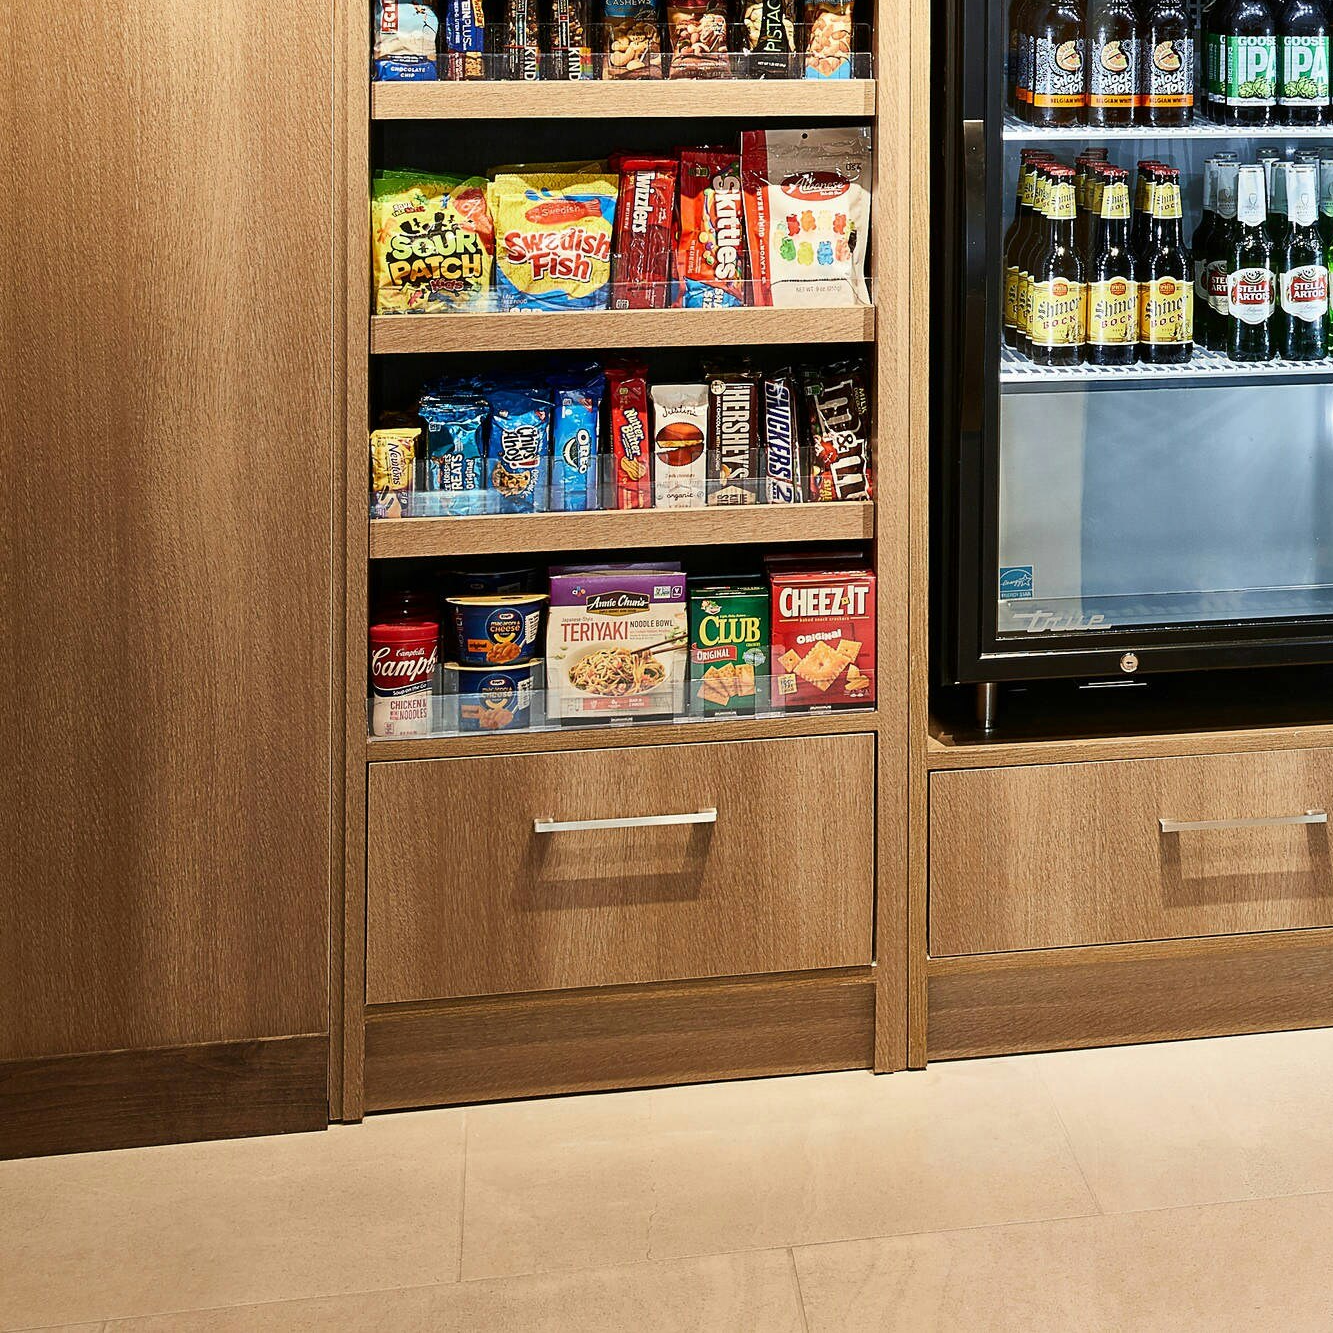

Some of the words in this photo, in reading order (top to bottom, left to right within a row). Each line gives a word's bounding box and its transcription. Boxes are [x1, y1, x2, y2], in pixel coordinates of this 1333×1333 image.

[1238, 36, 1277, 46] GOOSE
[1284, 36, 1326, 46] GOOSE
[525, 46, 536, 81] KIND
[569, 47, 580, 81] KIND
[1238, 46, 1277, 85] IPA
[1284, 46, 1329, 85] IPA
[1054, 71, 1084, 88] SHOCK
[1067, 81, 1084, 94] TOP
[1100, 71, 1133, 88] SHOCK
[1112, 81, 1132, 94] TOP
[1152, 71, 1186, 88] SHOCK
[1163, 81, 1184, 94] TOP
[542, 205, 580, 217] Swedish
[632, 171, 655, 233] Twizzlers
[713, 175, 740, 280] Skittles
[391, 229, 476, 260] SOUR
[504, 227, 611, 262] Swedish
[389, 254, 482, 286] PATCH
[529, 251, 591, 281] Fish
[1237, 284, 1269, 293] STELLA
[1237, 292, 1270, 301] ARTOIS
[1293, 282, 1325, 291] STELLA
[1293, 290, 1325, 299] ARTOIS
[1038, 297, 1081, 320] Shiner
[1095, 296, 1138, 320] Shiner
[1145, 295, 1188, 321] Shiner
[1043, 315, 1077, 329] BOCK
[1101, 314, 1133, 328] BOCK
[1151, 313, 1184, 328] BOCK
[858, 387, 868, 415] MILK
[623, 408, 645, 439] Nutter
[722, 388, 750, 479] HERSHEY'S
[765, 383, 792, 481] SNICKERS
[516, 426, 538, 460] Chips
[577, 429, 590, 474] OREO
[621, 425, 641, 456] Butter
[388, 443, 401, 485] Newtons
[451, 454, 463, 494] REATS
[465, 459, 475, 490] Original
[666, 492, 693, 501] organic
[777, 485, 792, 503] 2
[587, 596, 616, 610] Annie
[618, 594, 649, 607] Chun's
[561, 621, 628, 642] TERIYAKI
[699, 615, 761, 646] CLUB
[1013, 609, 1113, 633] true
[696, 647, 730, 661] ORIGINAL
[390, 699, 421, 710] CHICKEN
[400, 708, 427, 720] NOODLES
